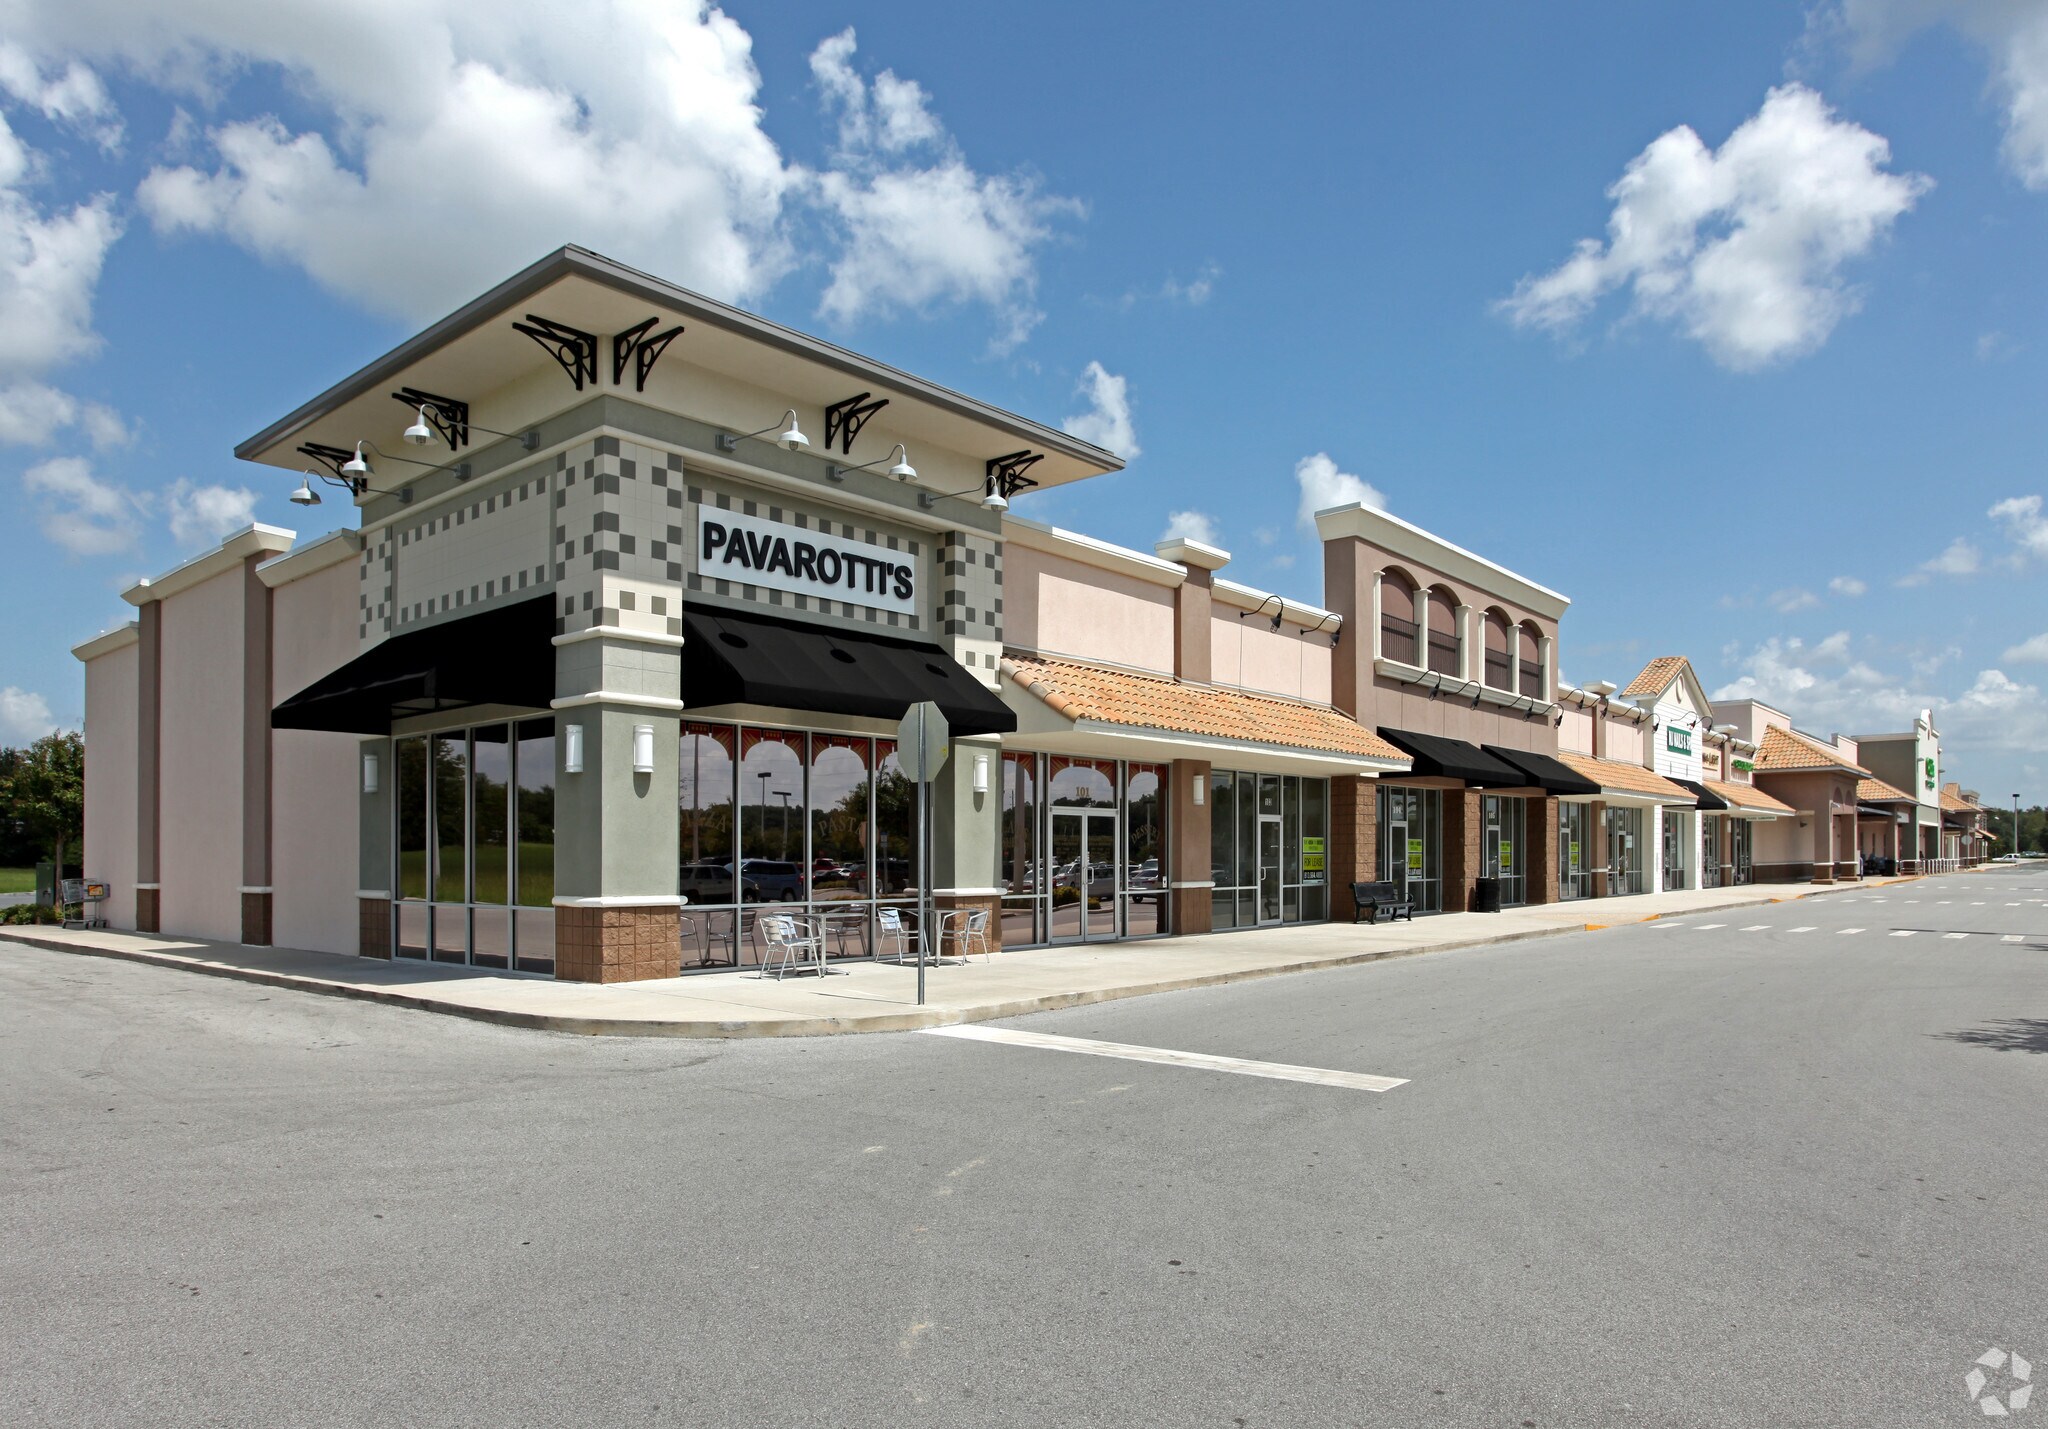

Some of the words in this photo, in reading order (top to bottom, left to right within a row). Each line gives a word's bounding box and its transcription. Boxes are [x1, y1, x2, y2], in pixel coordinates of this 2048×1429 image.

[703, 520, 914, 600] PAVAROTTI'S
[1076, 786, 1090, 797] 101
[818, 815, 866, 837] PASTA
[1312, 857, 1323, 867] LEASE
